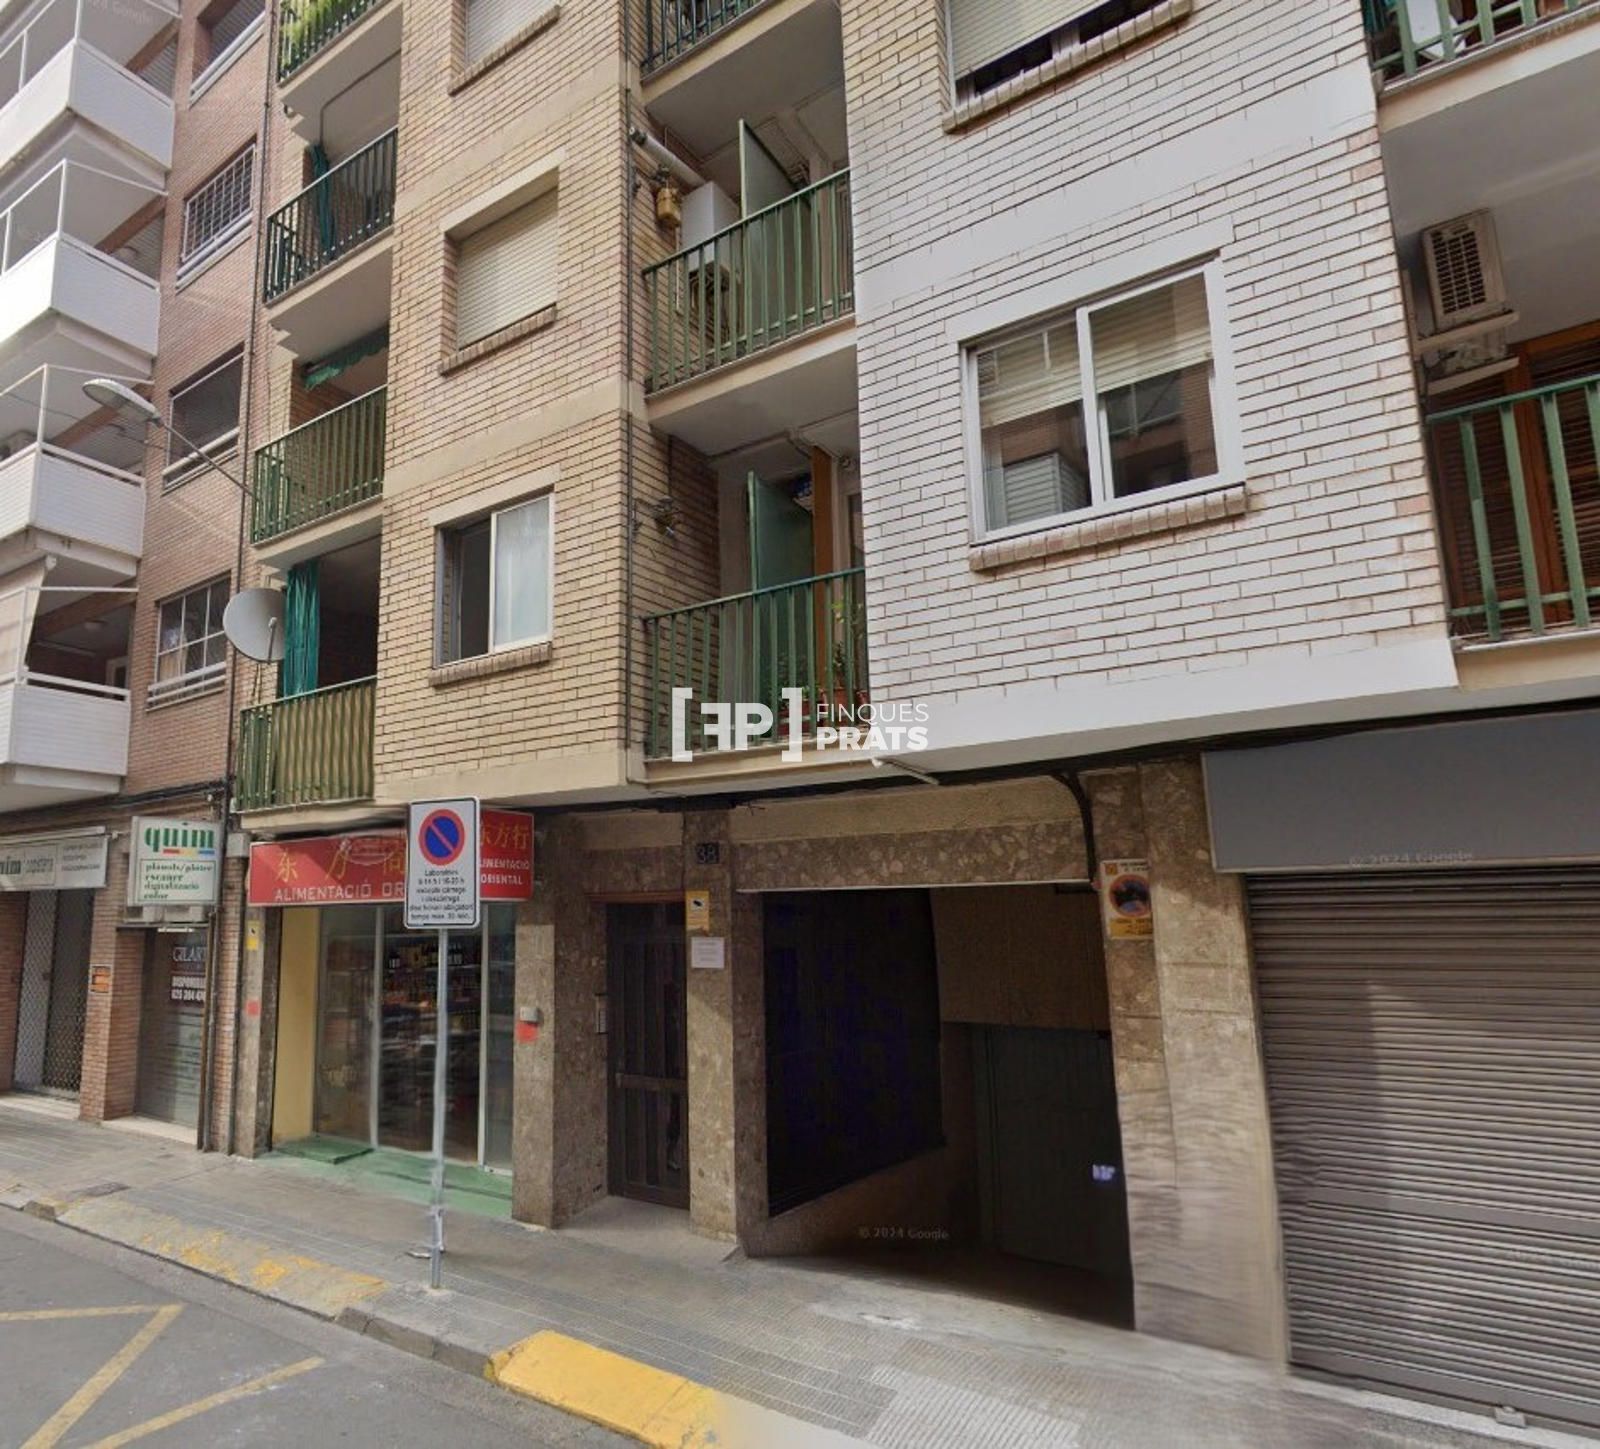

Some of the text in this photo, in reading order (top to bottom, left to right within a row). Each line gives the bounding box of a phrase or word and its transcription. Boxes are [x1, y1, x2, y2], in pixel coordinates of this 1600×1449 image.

[144, 827, 215, 853] quim
[274, 878, 372, 901] ALIMENTACIÓ
[480, 873, 523, 887] ORIENTAL
